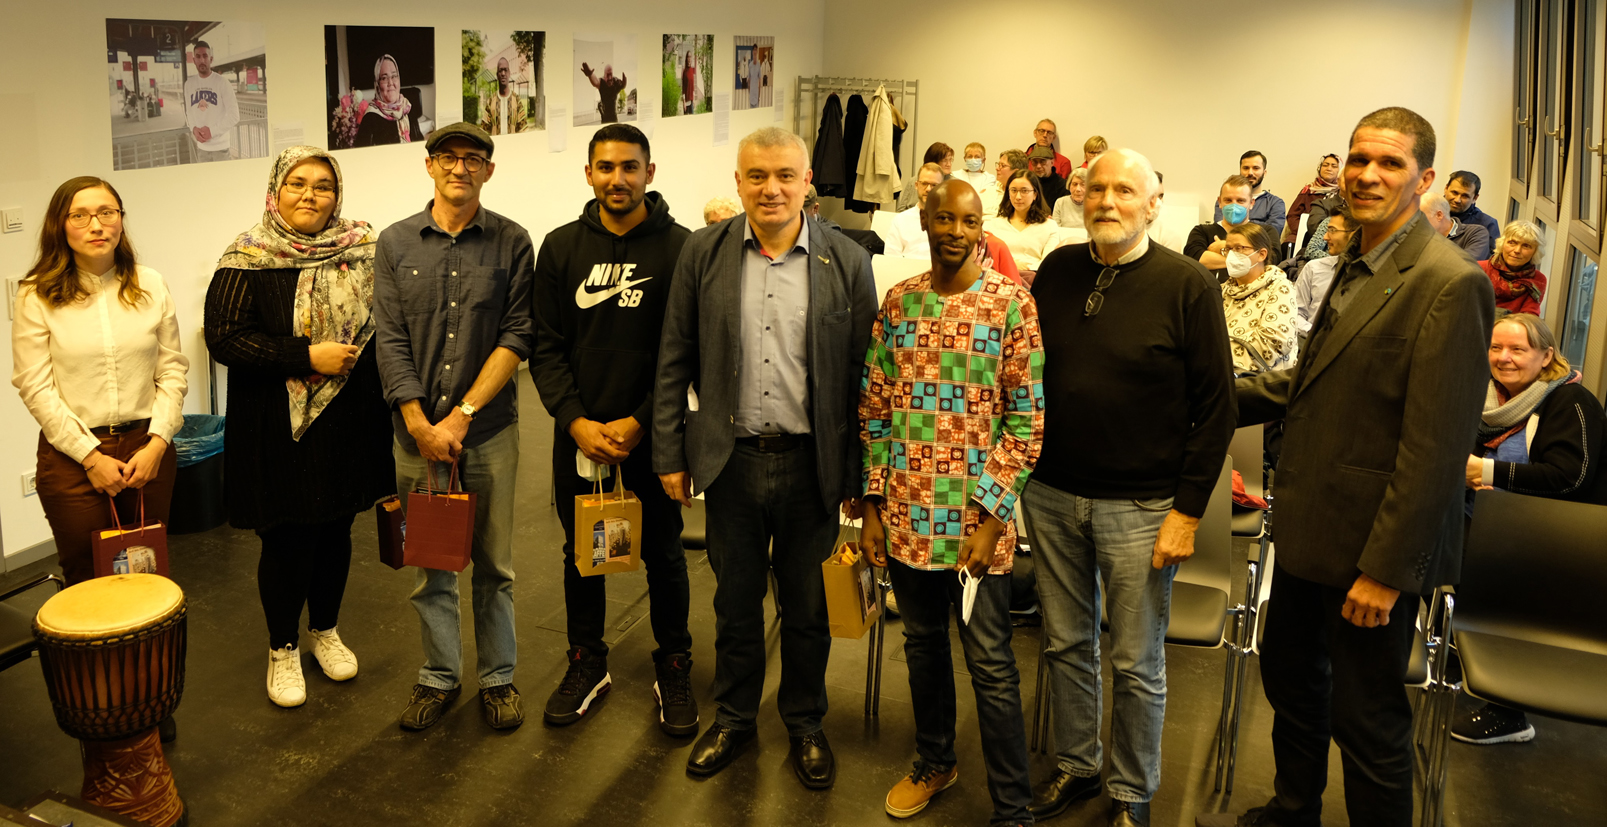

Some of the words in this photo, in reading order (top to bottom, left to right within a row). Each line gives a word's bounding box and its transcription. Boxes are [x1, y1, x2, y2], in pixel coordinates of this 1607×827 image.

[165, 33, 172, 43] 2
[585, 263, 637, 286] NIKE
[618, 288, 644, 308] SB
